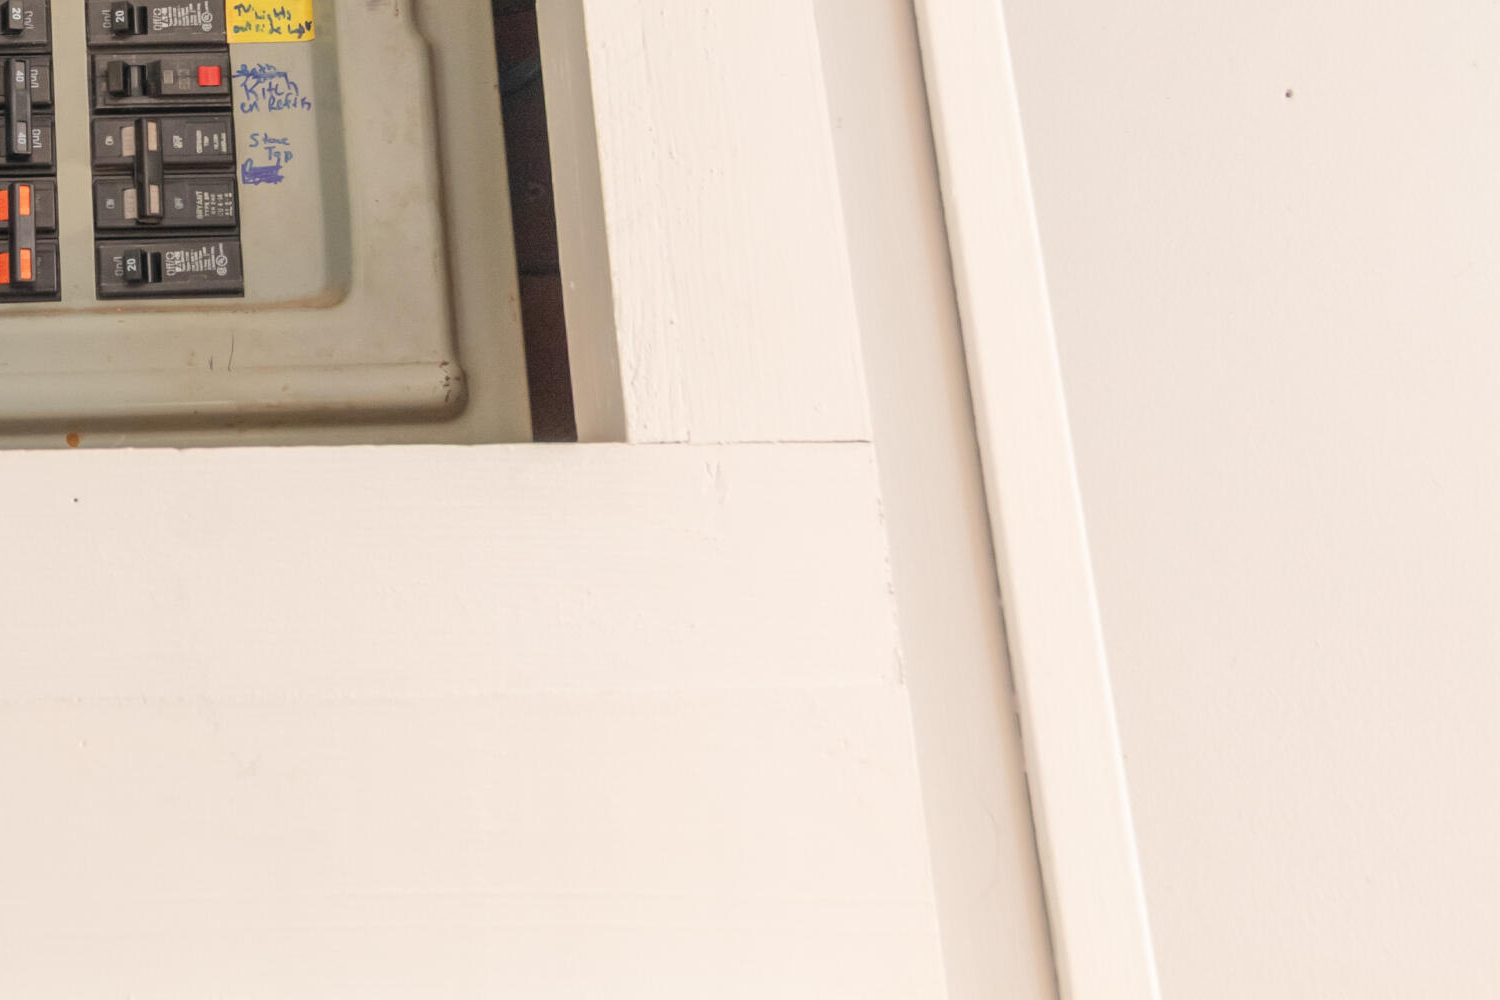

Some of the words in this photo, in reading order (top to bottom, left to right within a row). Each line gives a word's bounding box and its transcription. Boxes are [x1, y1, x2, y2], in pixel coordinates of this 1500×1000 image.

[11, 7, 22, 20] 20
[115, 10, 125, 23] 20
[16, 70, 25, 82] 40
[18, 132, 27, 145] 40
[126, 259, 137, 271] 20
